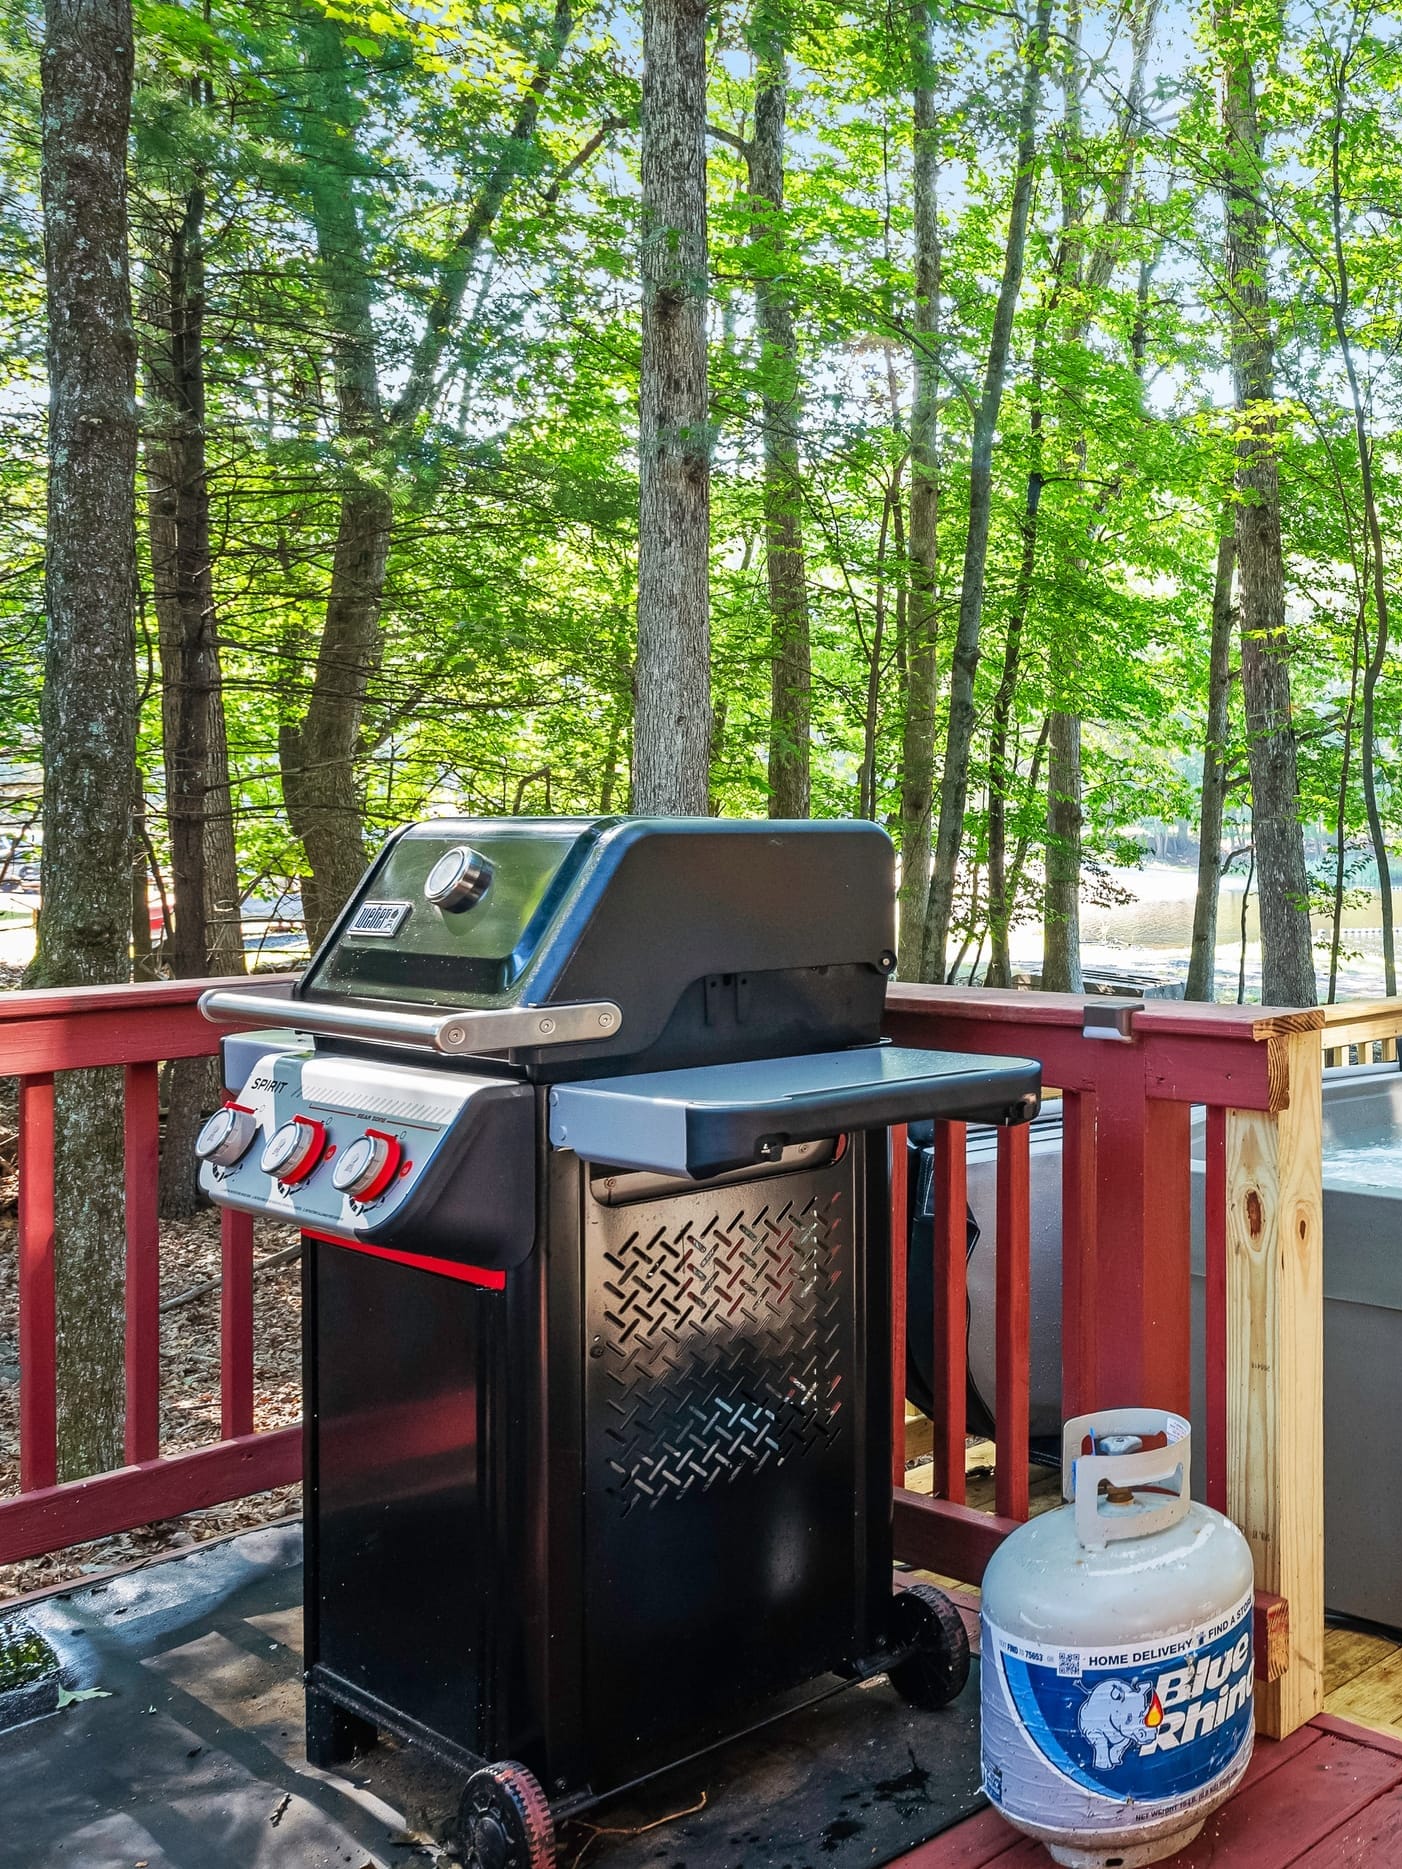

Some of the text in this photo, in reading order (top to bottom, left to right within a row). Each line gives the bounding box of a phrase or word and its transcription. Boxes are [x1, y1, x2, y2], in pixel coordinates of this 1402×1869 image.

[251, 1078, 288, 1094] SPIRIT
[1089, 1595, 1252, 1666] HOME DELIVERY FIND A STOR
[1156, 1632, 1249, 1709] Blue
[1135, 1813, 1149, 1821] NET
